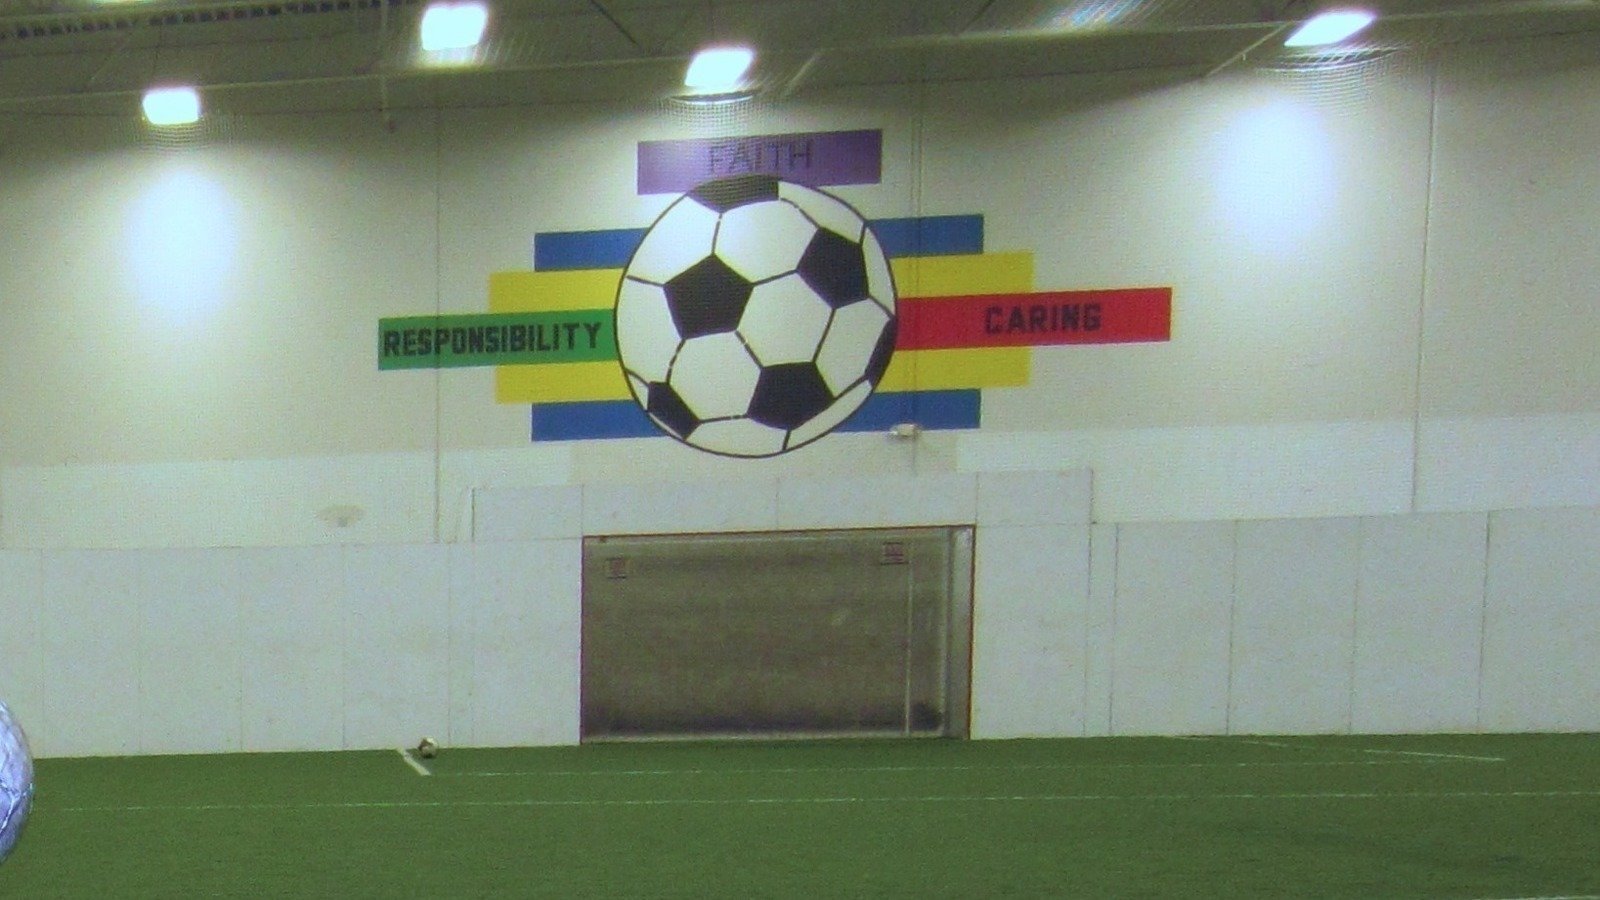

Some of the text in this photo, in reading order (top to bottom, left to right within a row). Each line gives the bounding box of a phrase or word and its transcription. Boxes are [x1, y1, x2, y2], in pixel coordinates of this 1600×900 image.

[710, 141, 812, 175] FAITH
[985, 303, 1103, 334] CARING
[383, 322, 602, 357] RESPONSIBILITY
